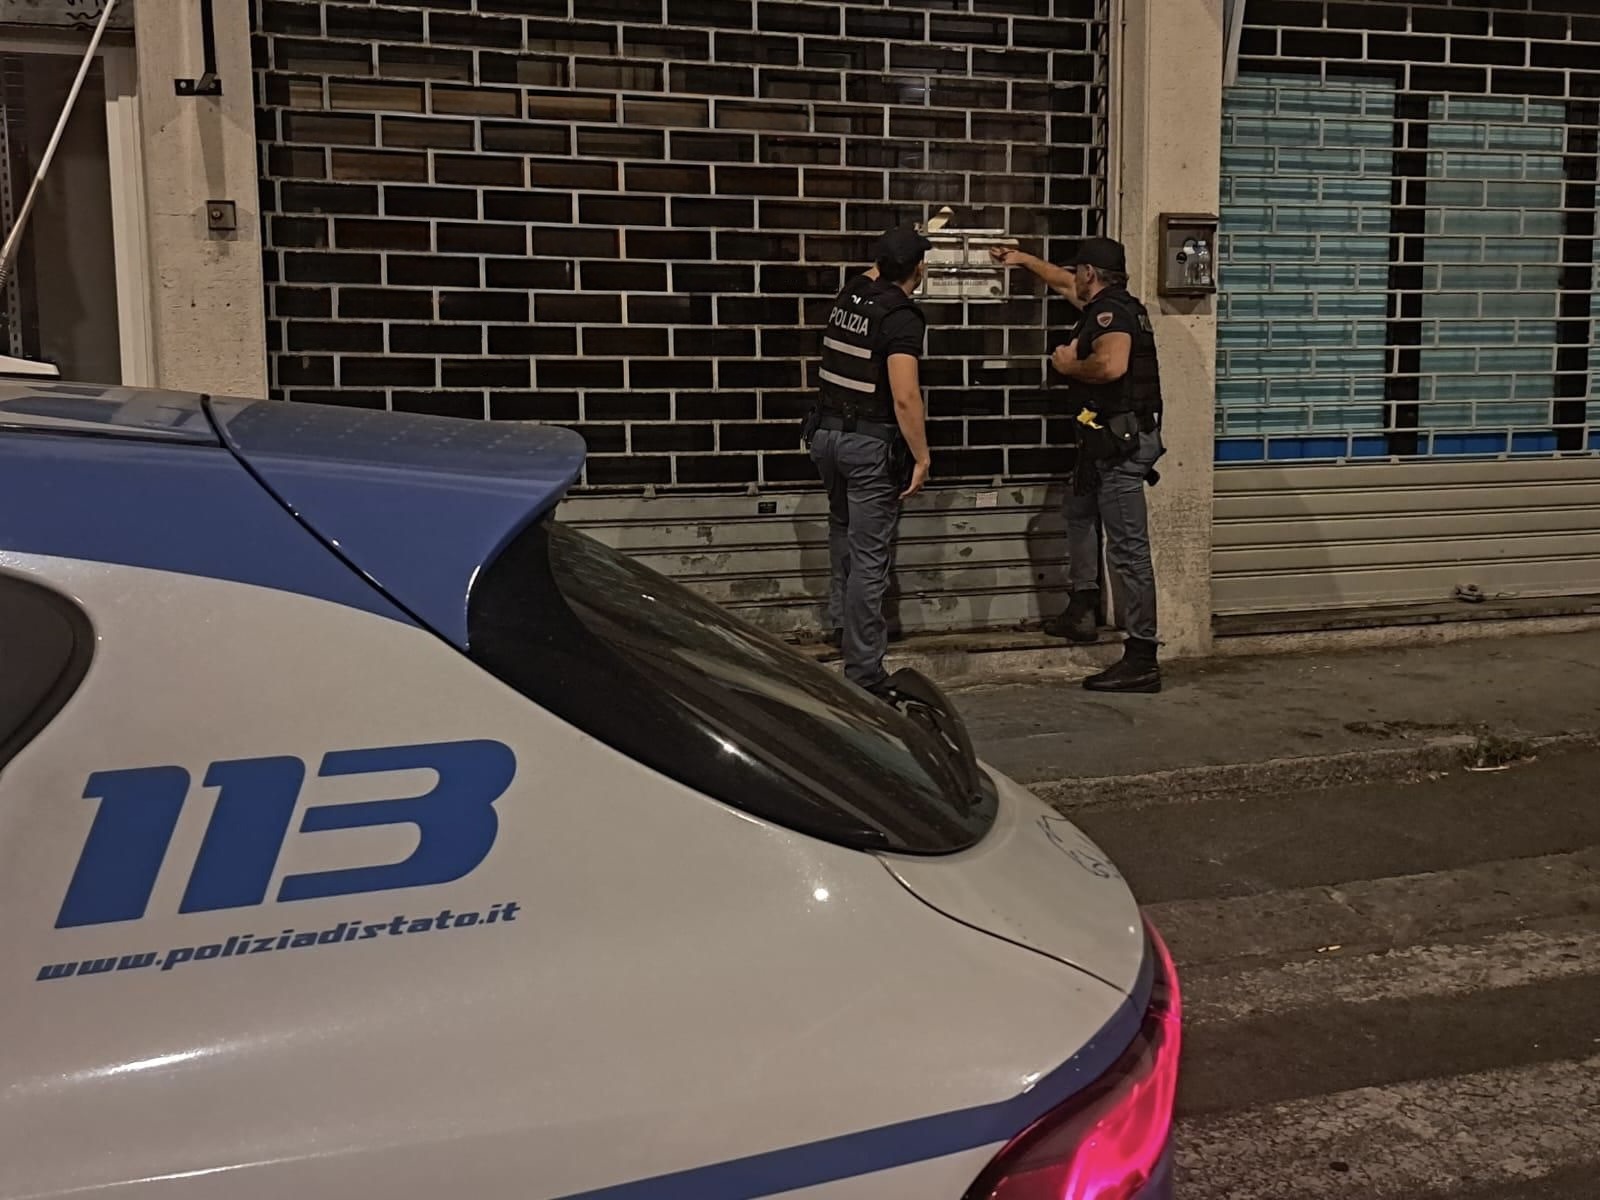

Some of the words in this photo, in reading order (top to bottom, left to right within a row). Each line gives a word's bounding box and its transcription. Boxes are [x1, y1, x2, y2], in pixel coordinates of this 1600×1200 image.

[829, 307, 869, 336] POLIZIA
[54, 739, 517, 929] 113
[36, 902, 521, 981] www.poliziadistato.it
